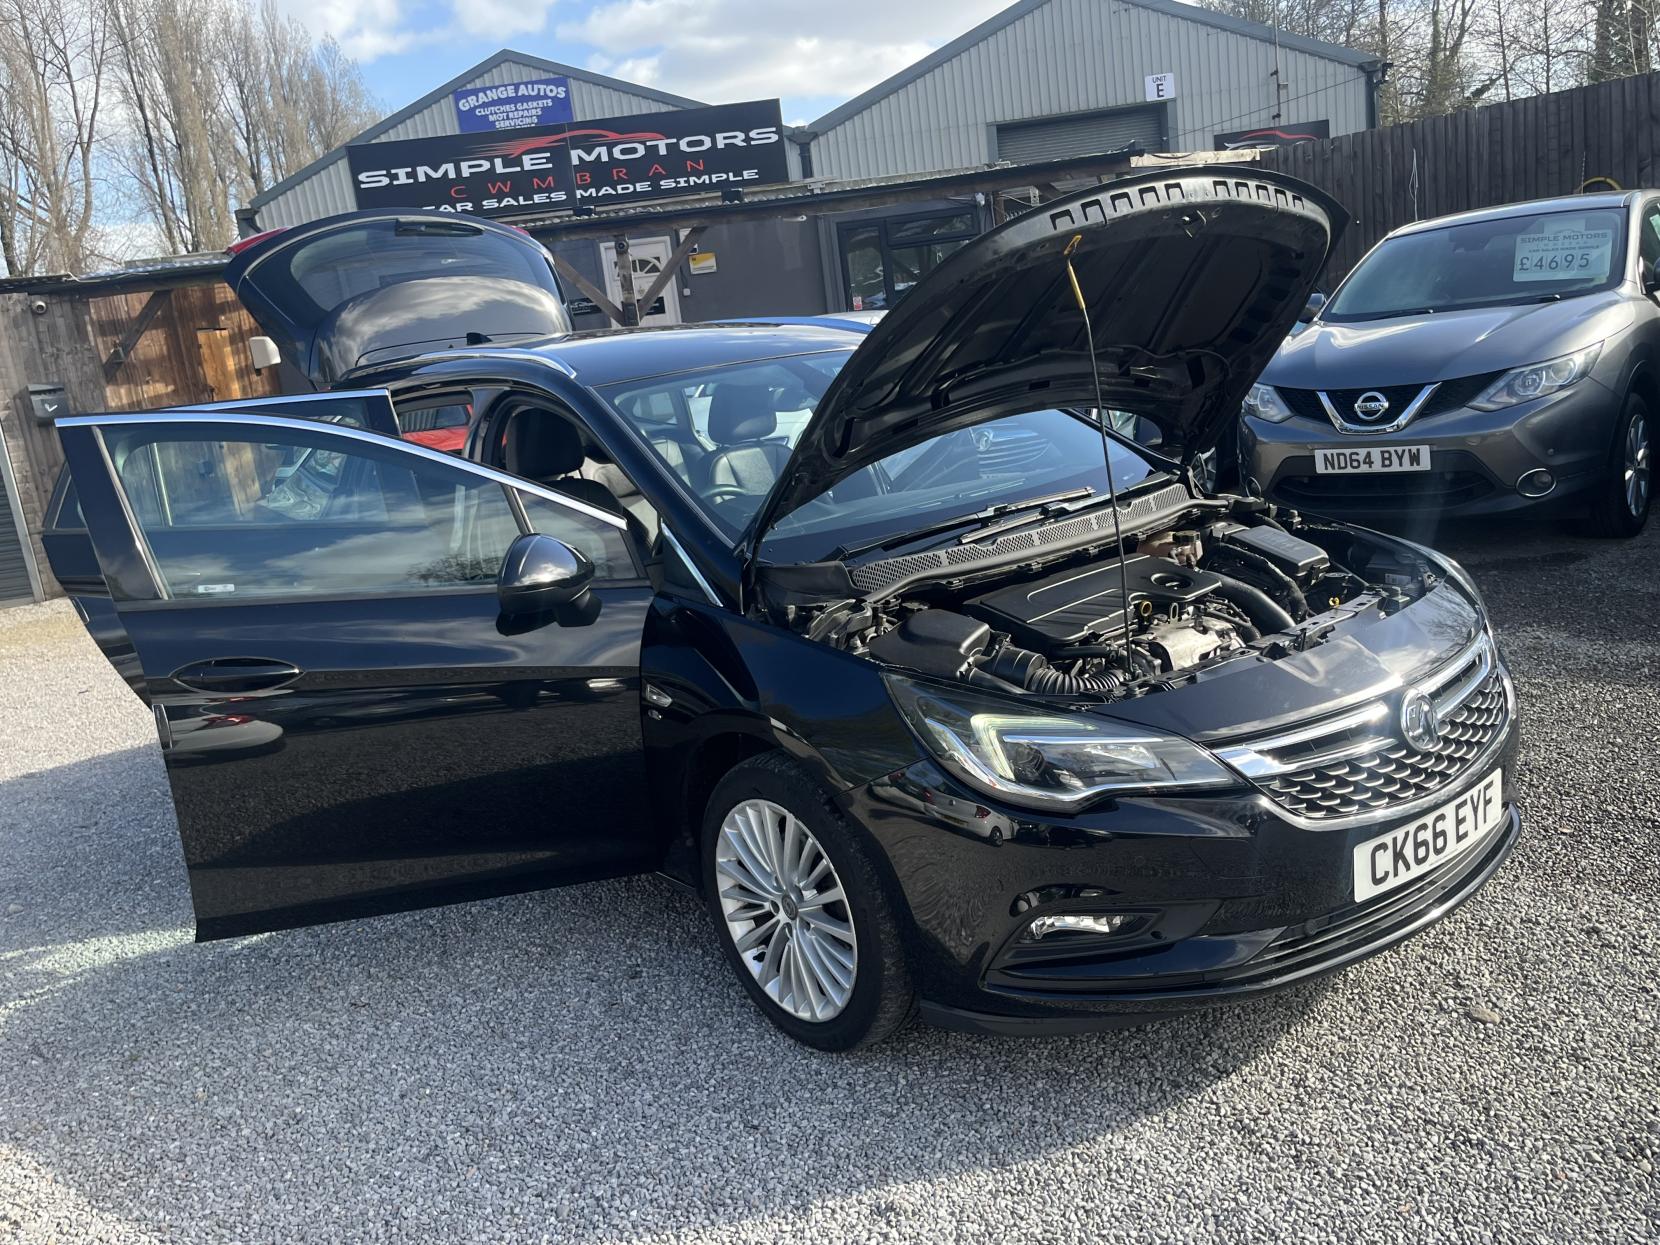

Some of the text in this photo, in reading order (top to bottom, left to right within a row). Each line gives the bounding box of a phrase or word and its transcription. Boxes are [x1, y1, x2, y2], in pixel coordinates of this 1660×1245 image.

[1152, 75, 1166, 83] UNIT
[459, 84, 566, 111] GRANGE AUTOS
[1156, 83, 1164, 98] E
[475, 99, 552, 116] CLUTCHES GASKETS
[489, 108, 542, 122] MOT REPAIRS
[495, 116, 538, 128] SERVICING
[358, 127, 779, 188] SIMPLE MOTORS
[421, 169, 759, 214] AR SALES MADE SIMPLE
[1520, 235, 1560, 244] SIMPLE
[1562, 231, 1608, 241] MOTORS
[1518, 253, 1590, 272] £4695
[1323, 448, 1421, 471] ND64 BYW
[1370, 779, 1494, 887] CK66 EYF
